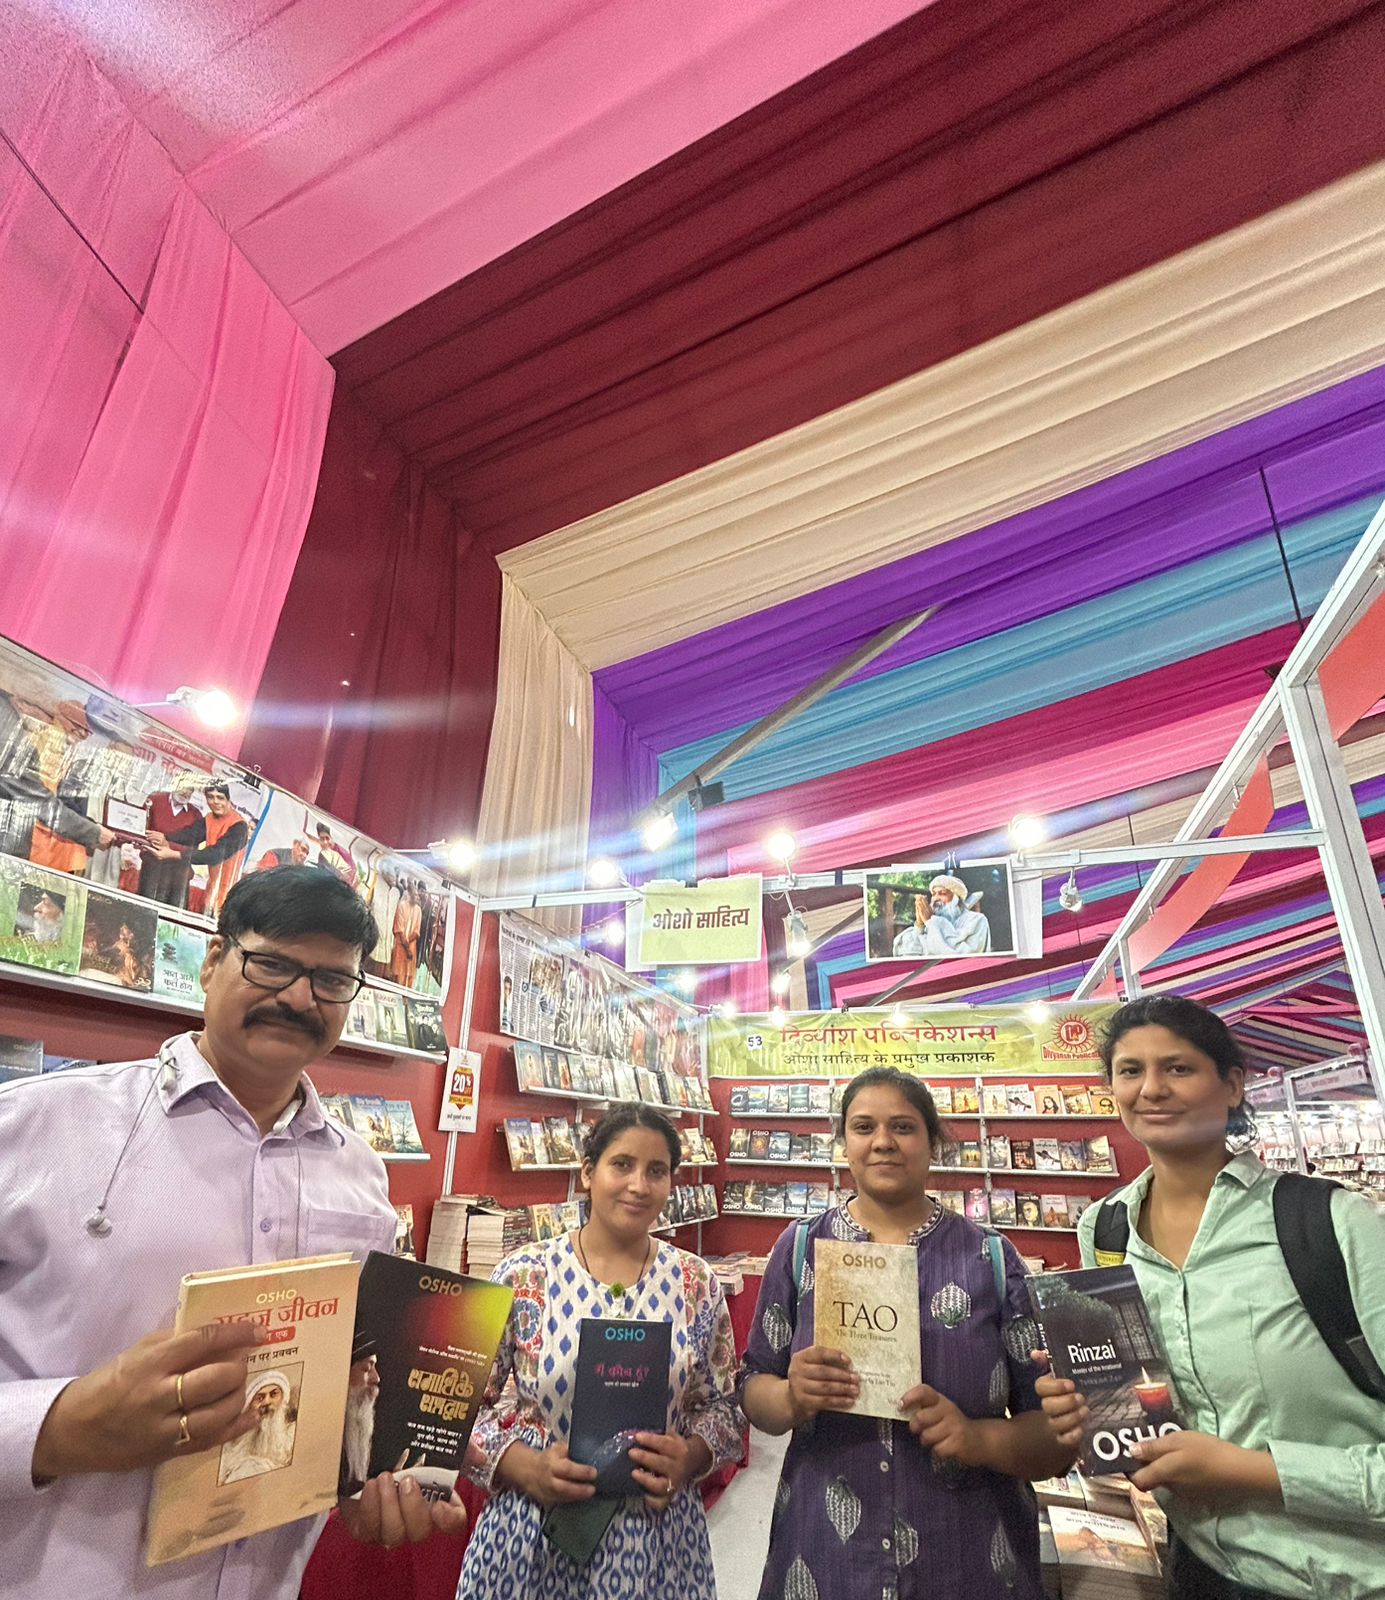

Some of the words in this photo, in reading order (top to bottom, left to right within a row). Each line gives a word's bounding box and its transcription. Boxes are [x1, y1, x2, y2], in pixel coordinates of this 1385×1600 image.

[653, 908, 693, 930] ओशो
[696, 905, 750, 929] साहित्य
[747, 1036, 763, 1047] 53
[780, 1024, 857, 1046] दिव्यांश
[863, 1020, 998, 1045] पब्लिकेशन्स
[784, 1051, 818, 1066] ओशो
[823, 1051, 868, 1066] साहित्य
[872, 1051, 888, 1064] के
[893, 1052, 930, 1068] प्रमुख
[934, 1051, 996, 1065] प्रकाशक
[453, 1074, 466, 1093] 20
[842, 1253, 887, 1270] OSHO
[418, 1275, 463, 1297] OSHO
[256, 1289, 298, 1304] OSHO
[278, 1296, 340, 1323] जीवन
[833, 1300, 899, 1333] TAO
[275, 1330, 289, 1340] एक
[605, 1327, 646, 1341] OSHO
[258, 1350, 271, 1362] पर
[272, 1346, 300, 1360] प्रवचन
[1067, 1339, 1117, 1364] Rinzai
